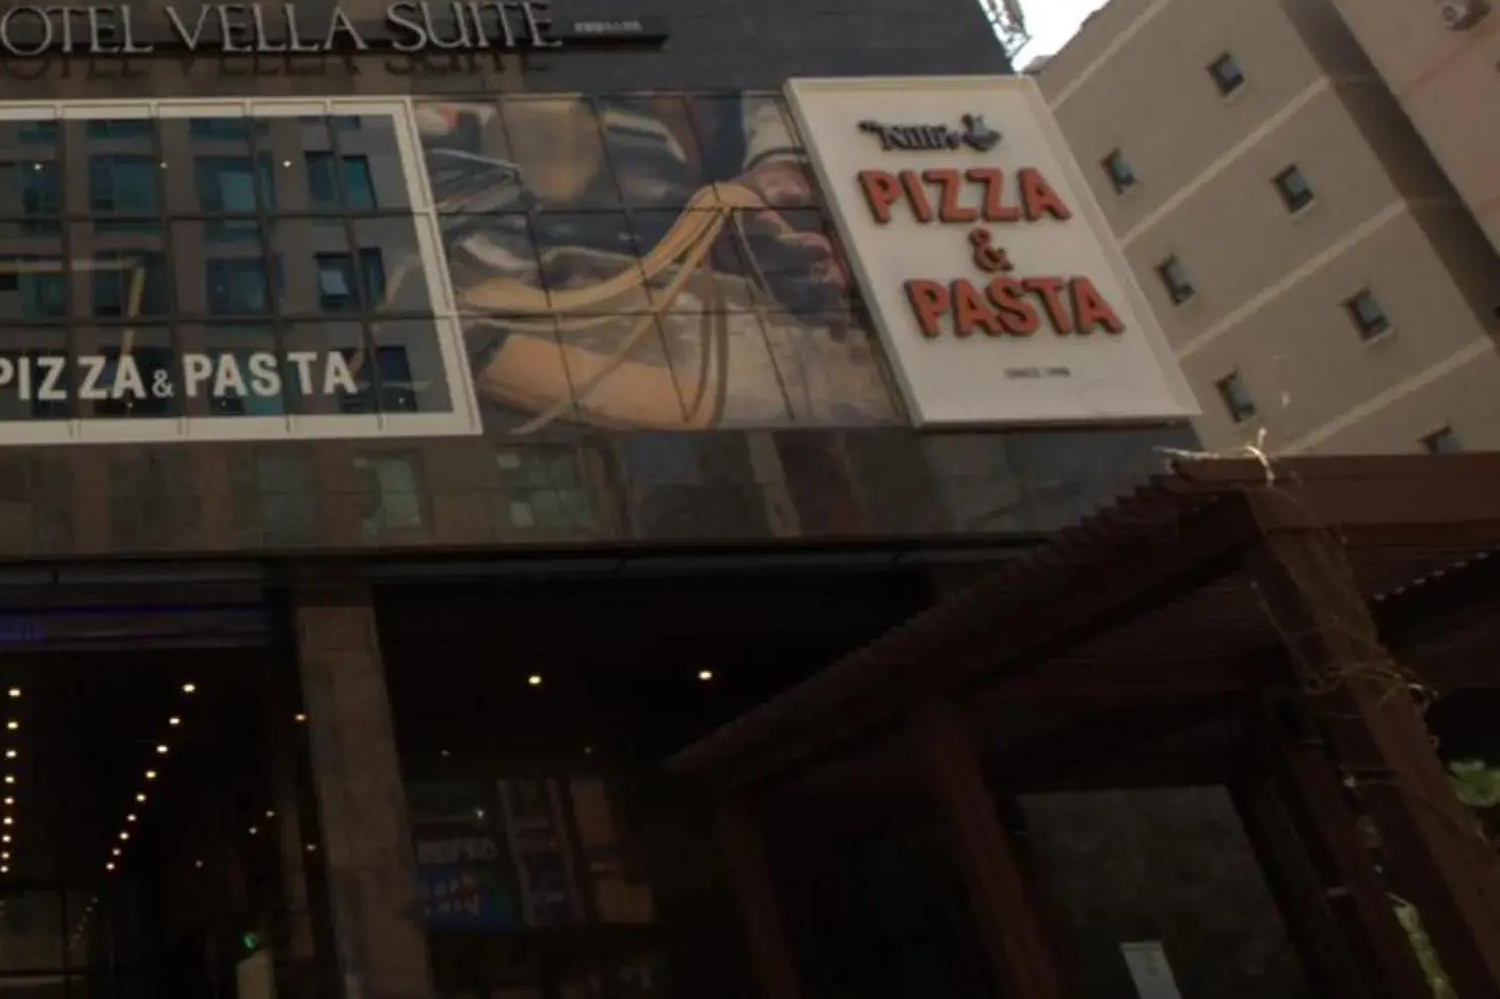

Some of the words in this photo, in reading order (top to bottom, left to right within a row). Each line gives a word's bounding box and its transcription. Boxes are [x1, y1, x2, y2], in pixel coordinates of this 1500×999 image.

[164, 3, 368, 55] VELLA
[385, 0, 564, 53] SUITE
[858, 167, 1073, 224] PIZZA
[968, 228, 1014, 273] &
[904, 276, 1126, 338] PASTA
[183, 350, 358, 398] PASTA
